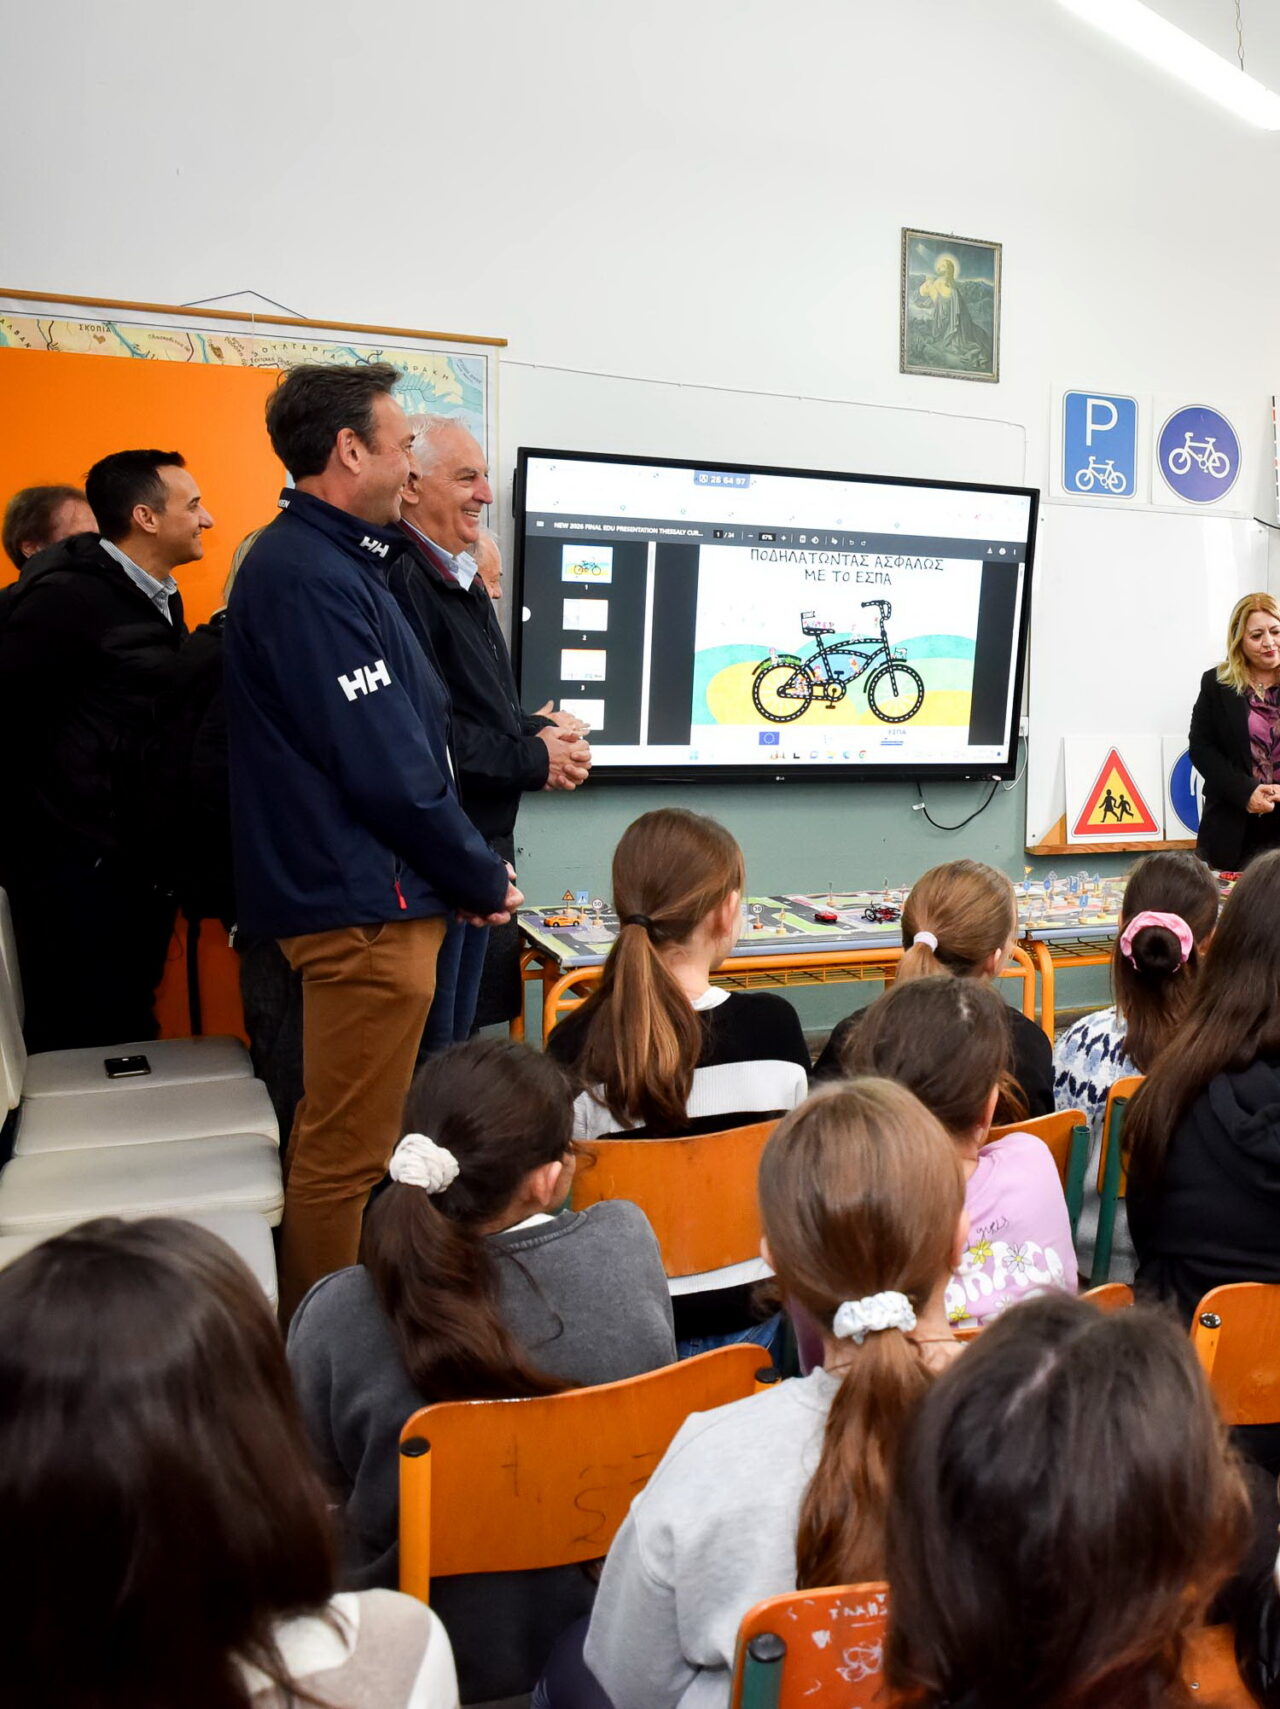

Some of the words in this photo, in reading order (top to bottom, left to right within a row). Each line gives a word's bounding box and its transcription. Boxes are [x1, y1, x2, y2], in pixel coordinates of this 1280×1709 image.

[78, 323, 112, 333] ΣΚΟΠΙΑ
[1085, 398, 1119, 446] P
[359, 535, 390, 558] HH
[750, 548, 870, 567] ΠΟΔΗΛΑΤΩΝΤΑΣ
[874, 554, 945, 571] ΑΣΦΑΛΩΣ
[804, 569, 826, 581] ΜΕ
[832, 570, 850, 582] ΤΟ
[856, 571, 892, 585] ΕΣΠΑ
[337, 659, 392, 702] HH
